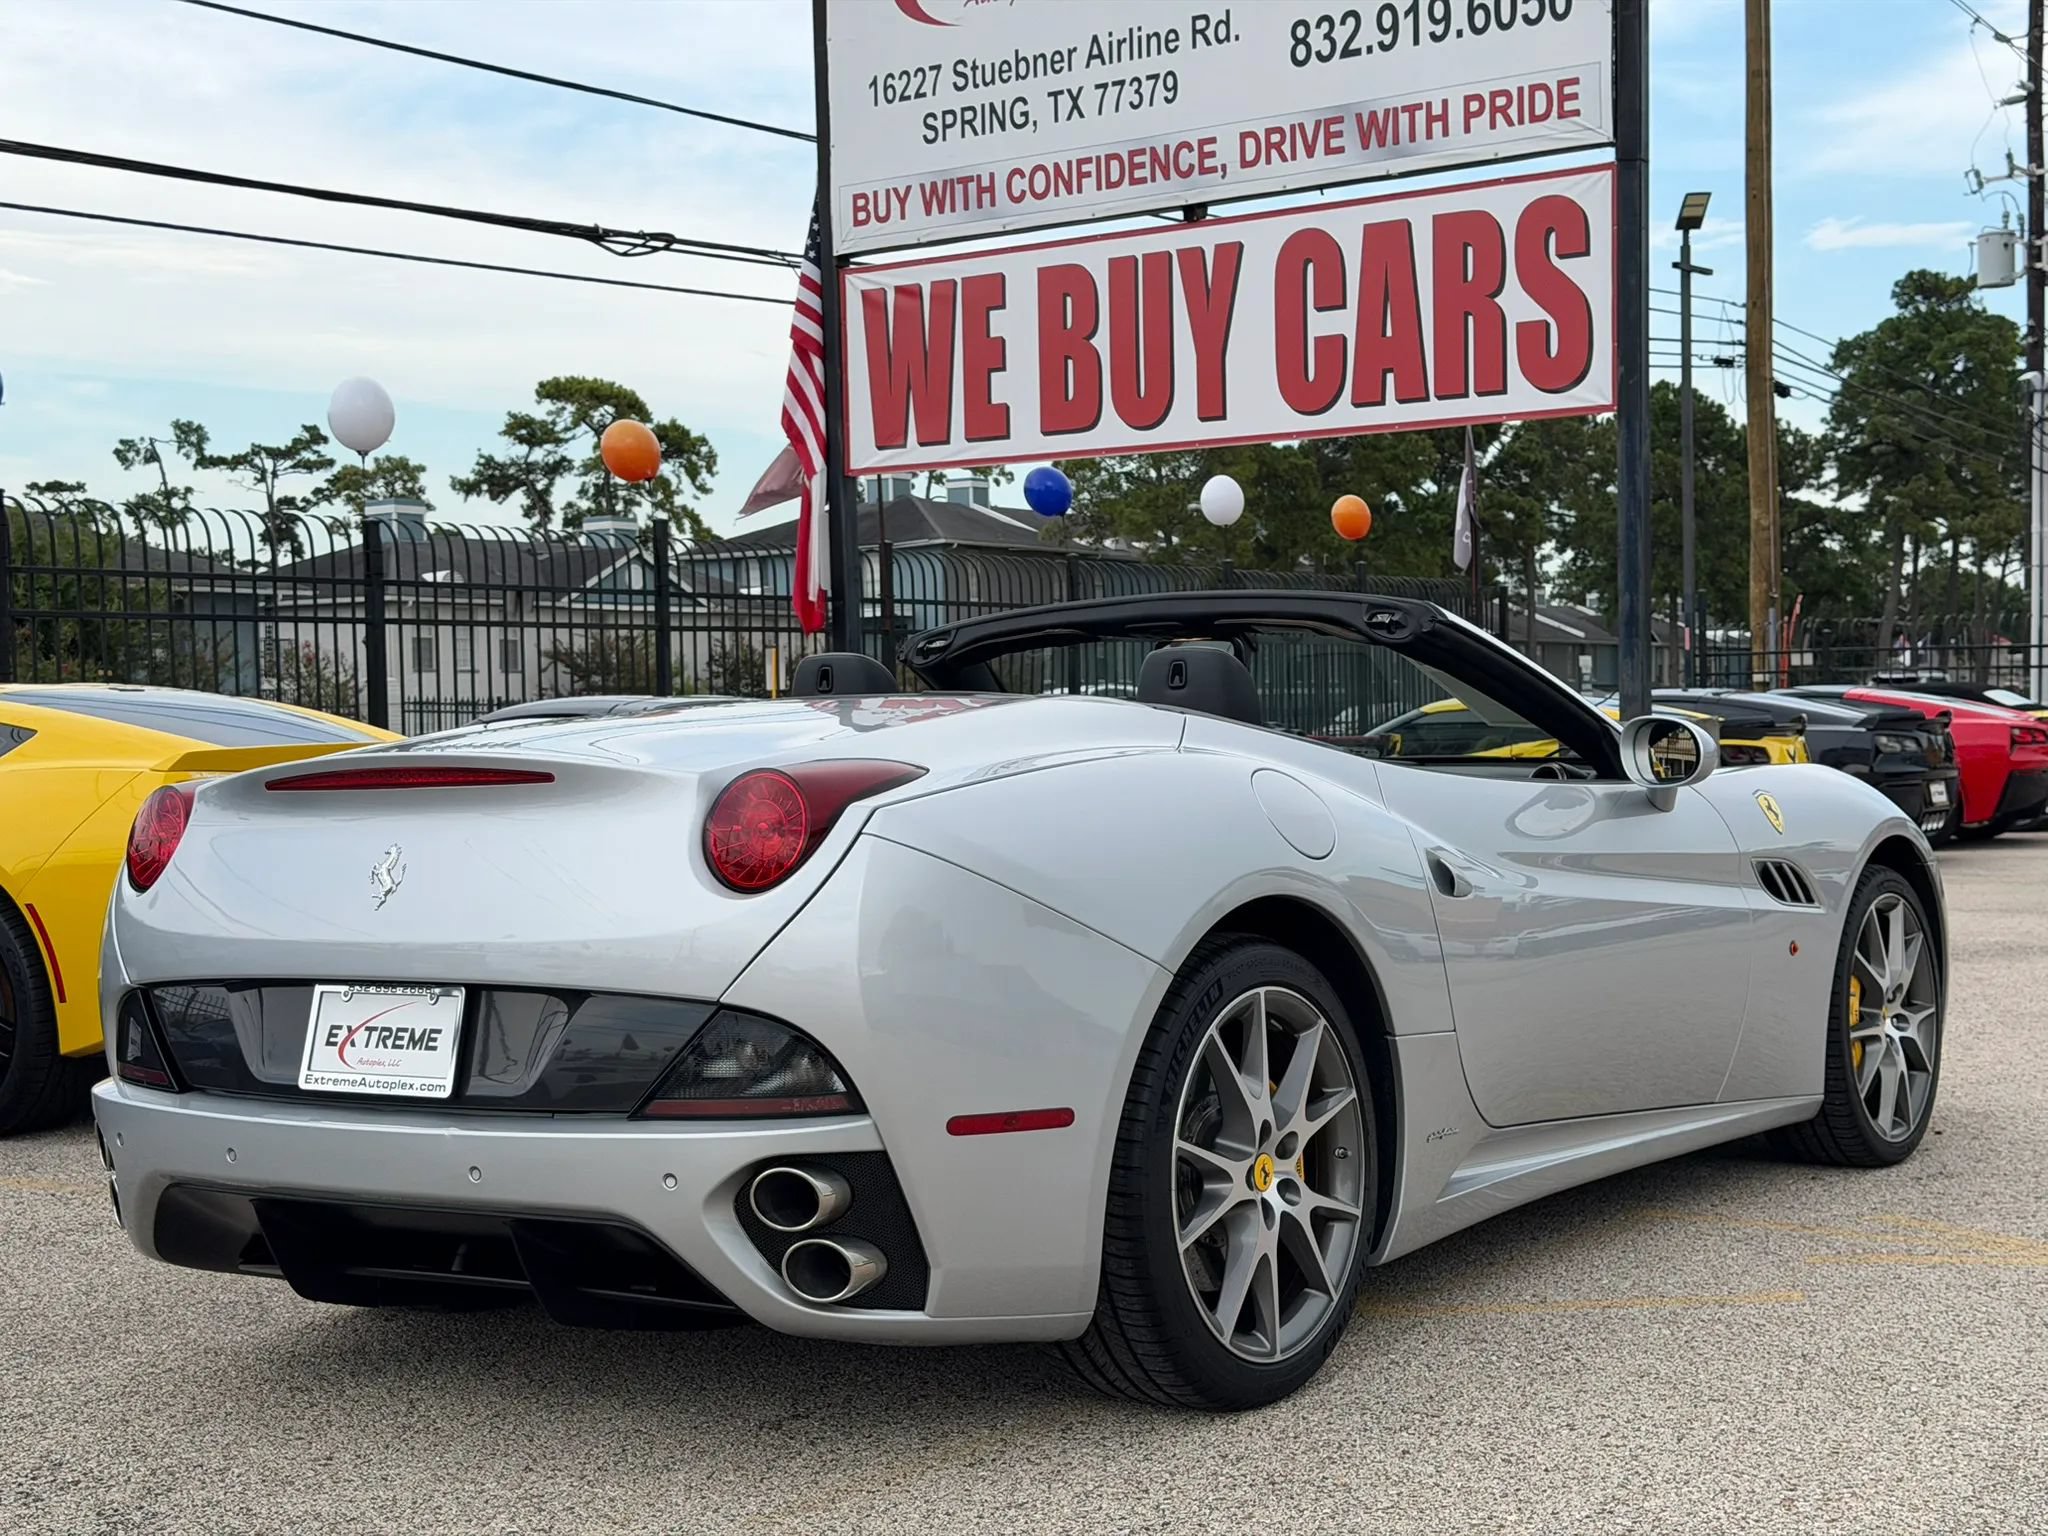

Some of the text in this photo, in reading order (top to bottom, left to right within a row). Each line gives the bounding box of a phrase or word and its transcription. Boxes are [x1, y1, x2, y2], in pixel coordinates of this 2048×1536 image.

[868, 8, 1241, 107] 16227 Stuebner Airline Rd.
[921, 70, 1179, 145] SPRING, TX 77379
[851, 76, 1582, 228] BUY WITH CONFIDENCE, DRIVE WITH PRIDE
[860, 194, 1592, 451] WE BUY CARS
[324, 1024, 443, 1052] EXTREME
[304, 1073, 447, 1093] ExtremeAutoplex.com
